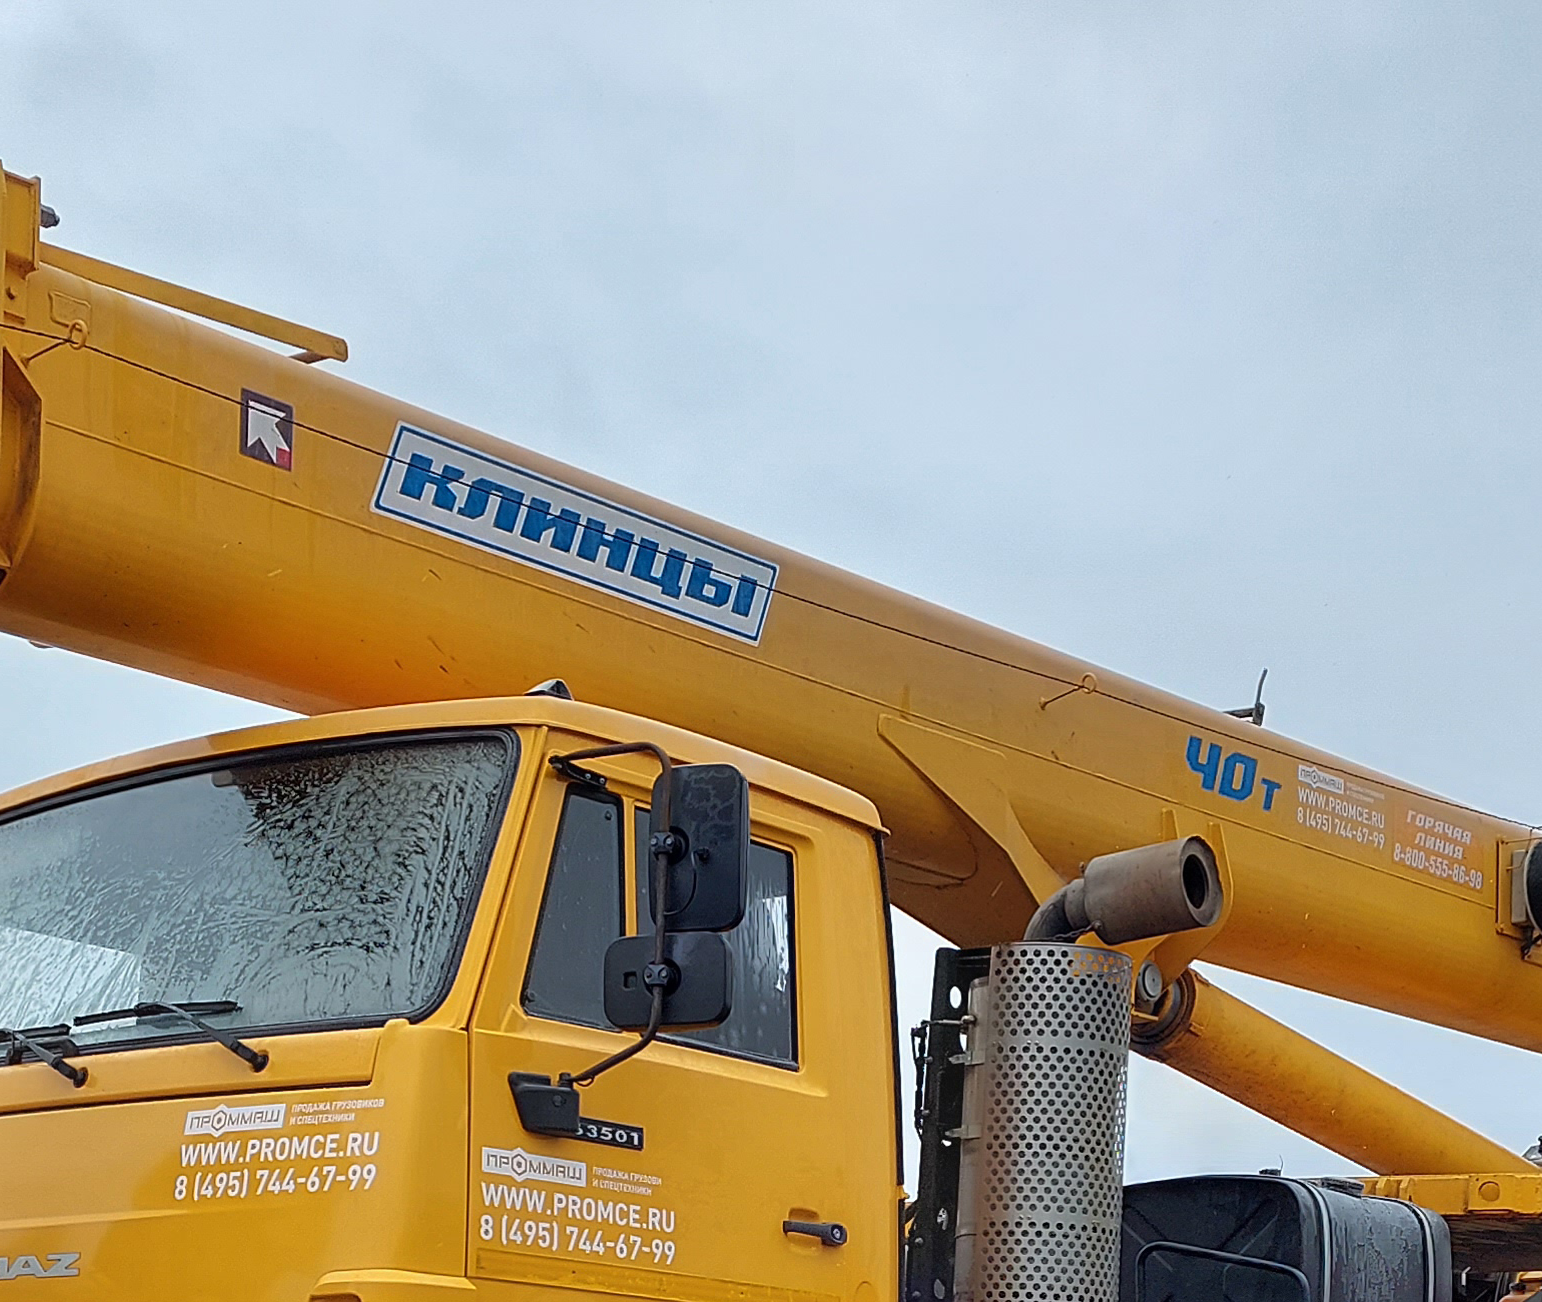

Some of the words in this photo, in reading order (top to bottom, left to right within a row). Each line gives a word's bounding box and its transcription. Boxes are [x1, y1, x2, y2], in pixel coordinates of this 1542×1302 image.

[399, 452, 758, 618] КЛИНЦЫ
[1297, 786, 1385, 829] WWW.PROMCE.RU
[1297, 807, 1304, 823] 8
[1306, 807, 1332, 834] (495)
[1334, 818, 1385, 850] 744-67-99
[1407, 809, 1472, 844] ГОРЯЧАЯ
[1415, 832, 1463, 860] ЛИНИЯ
[1393, 843, 1484, 889] 8-800-555-86-98
[190, 1109, 281, 1132] ПРОММАШ
[291, 1103, 331, 1113] ПРОДАЖА
[331, 1099, 384, 1111] ГРУЗОВИКОВ
[297, 1113, 355, 1126] СПЕЦТЕХНИКИ
[180, 1131, 380, 1168] WWW.PROMCE.RU
[486, 1152, 582, 1181] ПРОММАШ
[593, 1166, 629, 1180] ПРОДАЖА
[174, 1175, 187, 1200] 8
[194, 1168, 248, 1201] (495)
[256, 1163, 376, 1195] 744-67-99
[599, 1180, 652, 1196] СПЕЦТЕХНИКИ
[481, 1181, 675, 1233] WWW.PROMCE.RU
[480, 1215, 493, 1240] 8
[502, 1213, 558, 1251] (495)
[566, 1226, 675, 1265] 744-67-99
